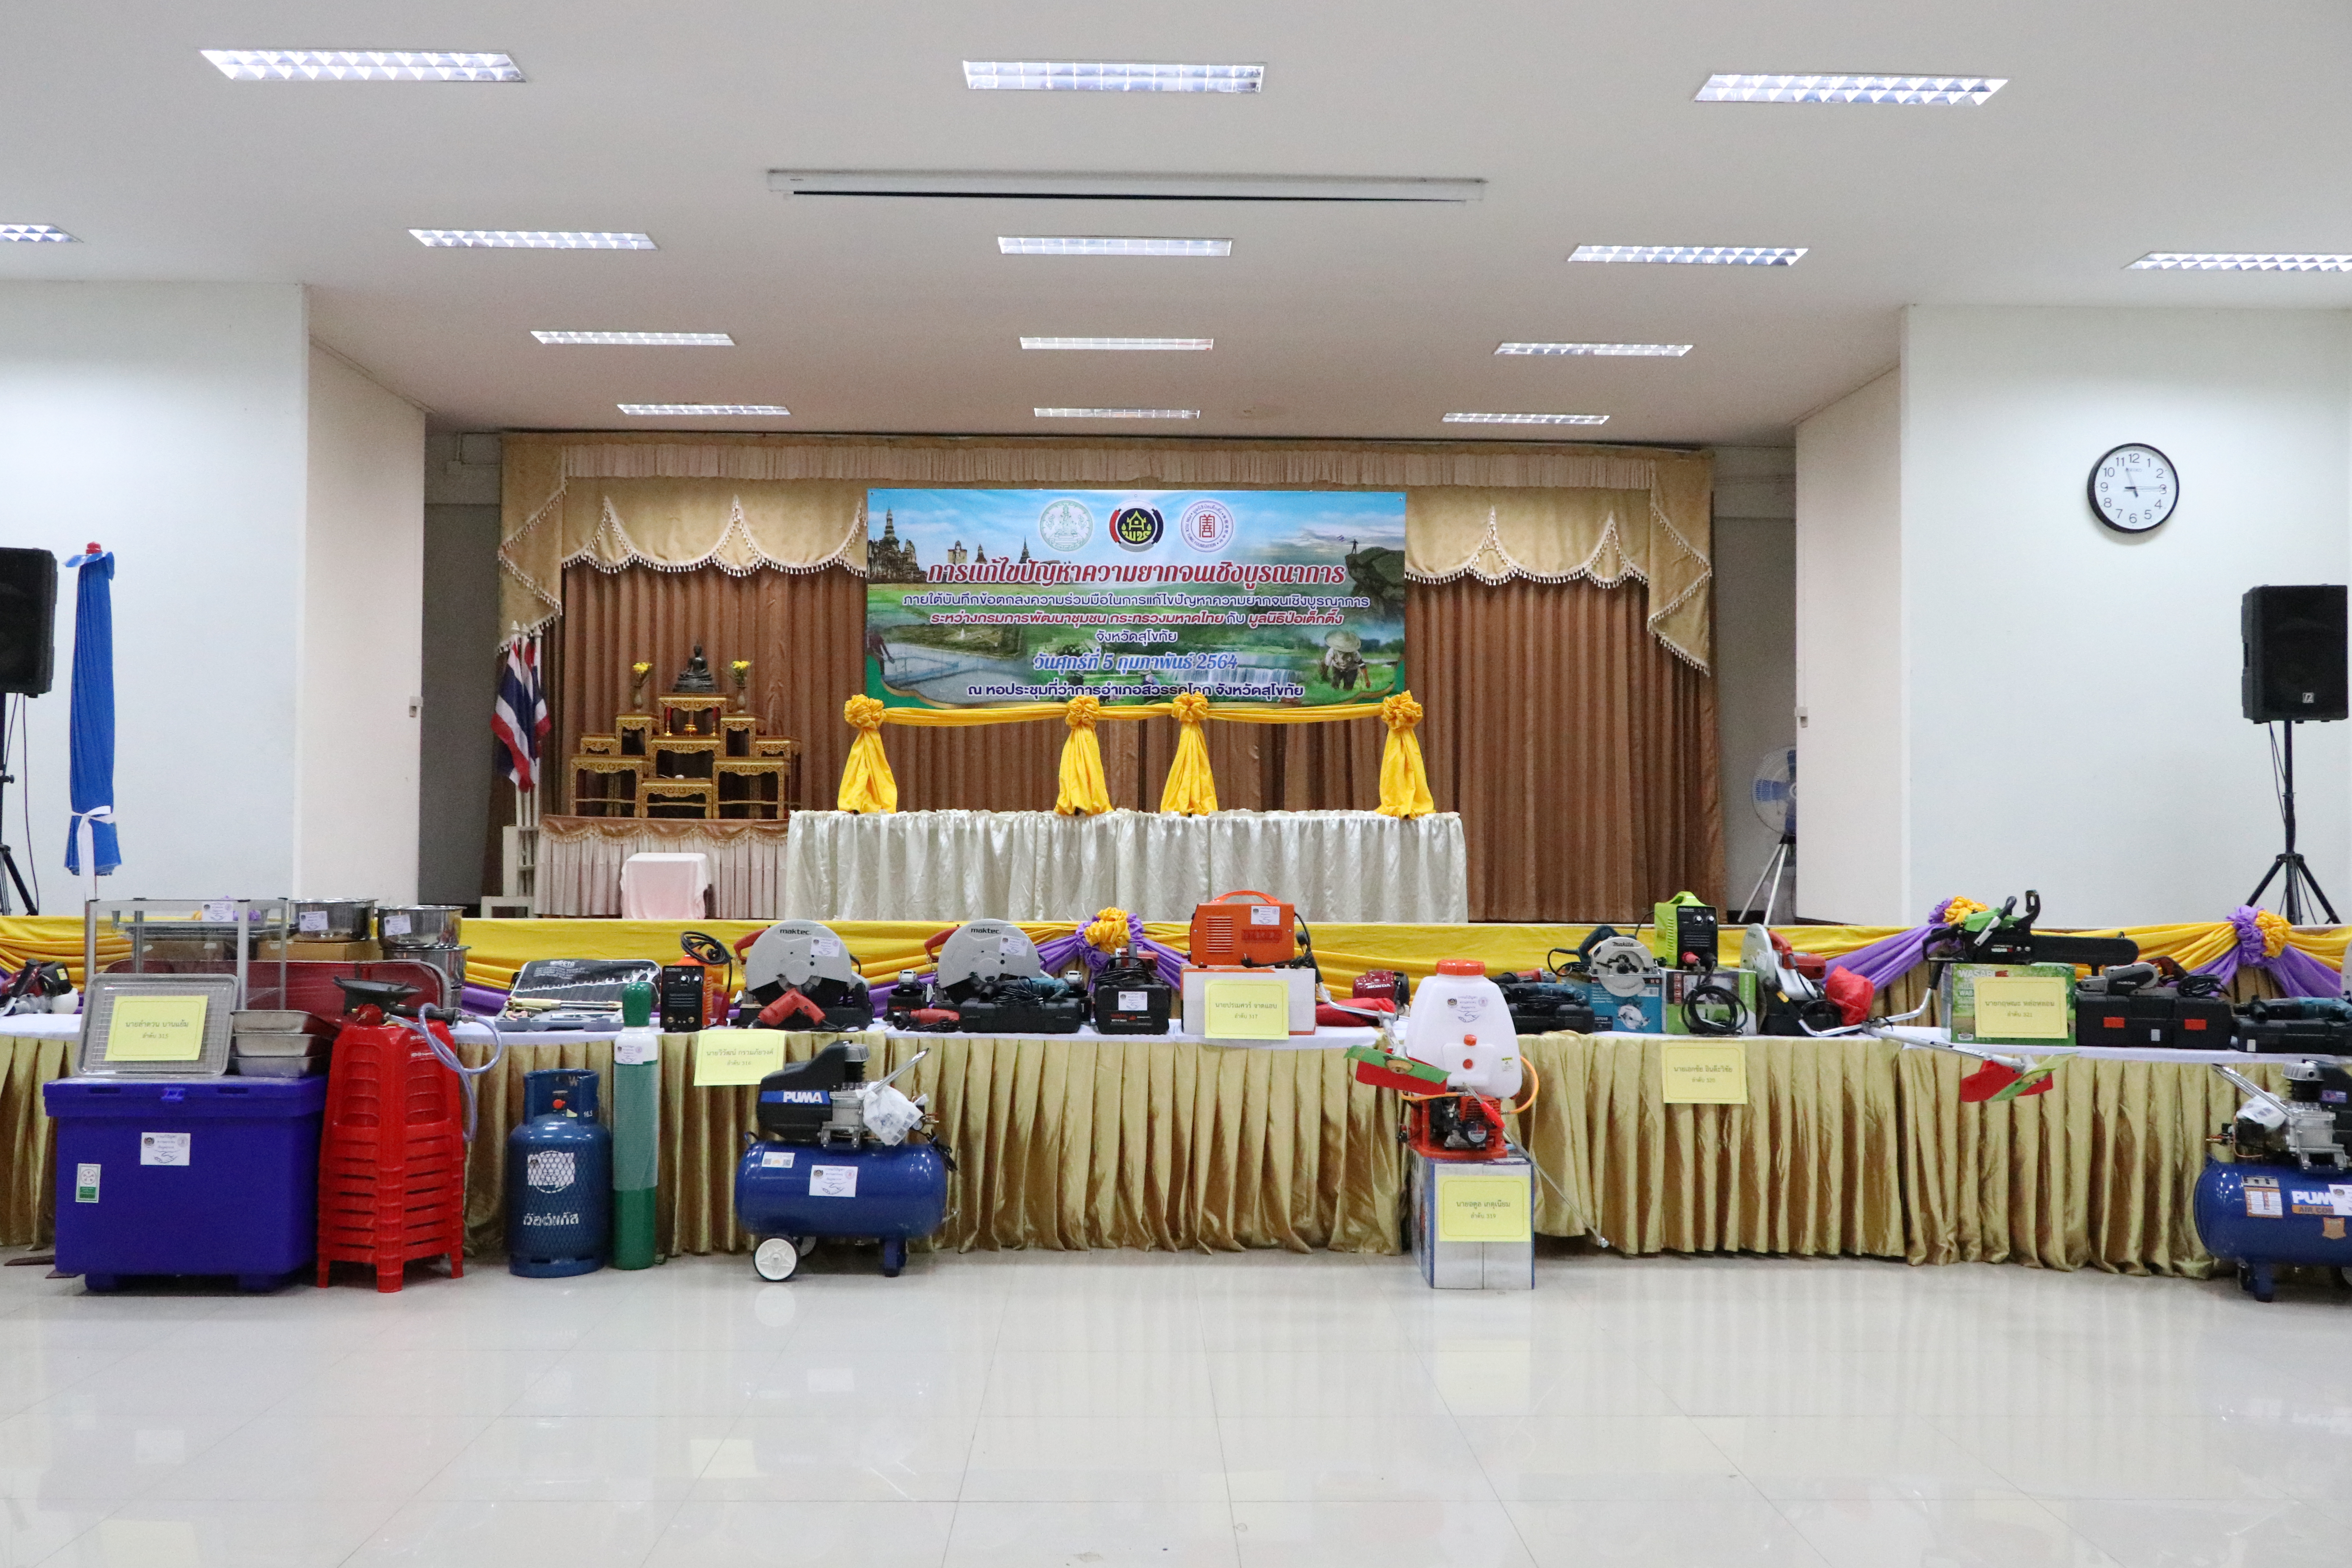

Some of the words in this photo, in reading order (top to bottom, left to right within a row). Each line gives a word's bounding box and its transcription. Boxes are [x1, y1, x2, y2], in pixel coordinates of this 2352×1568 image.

[2116, 457, 2125, 466] 11
[2129, 453, 2140, 463] 12
[2147, 458, 2151, 467] 1
[2104, 467, 2115, 477] 10
[2156, 468, 2164, 478] 2
[2100, 482, 2108, 492] 9
[2159, 484, 2167, 494] 3
[2103, 498, 2112, 508] 8
[2154, 499, 2162, 509] 4
[2116, 509, 2123, 518] 7
[2129, 514, 2137, 523] 6
[2144, 510, 2152, 519] 5
[931, 610, 1106, 627] ระหว่างกรมการพัฒนาชุมชน
[1110, 611, 1223, 624] กระทรวงมหาดไทย
[1226, 614, 1245, 624] กับ
[1248, 608, 1344, 627] มูลนิธิป่อเต็กตึ๊ง
[1096, 630, 1177, 645] จังหวัดสุโขทัย
[1034, 648, 1101, 673] วันศุกร์ที่
[1102, 653, 1114, 670] 5
[1116, 652, 1195, 673] กุมภาพันธ์
[1196, 652, 1238, 670] 2564
[968, 686, 981, 695] ณ
[1216, 683, 1304, 701] จังหวัดสุโขทัย
[783, 1092, 823, 1103] PUMA
[2292, 1191, 2333, 1205] PUM
